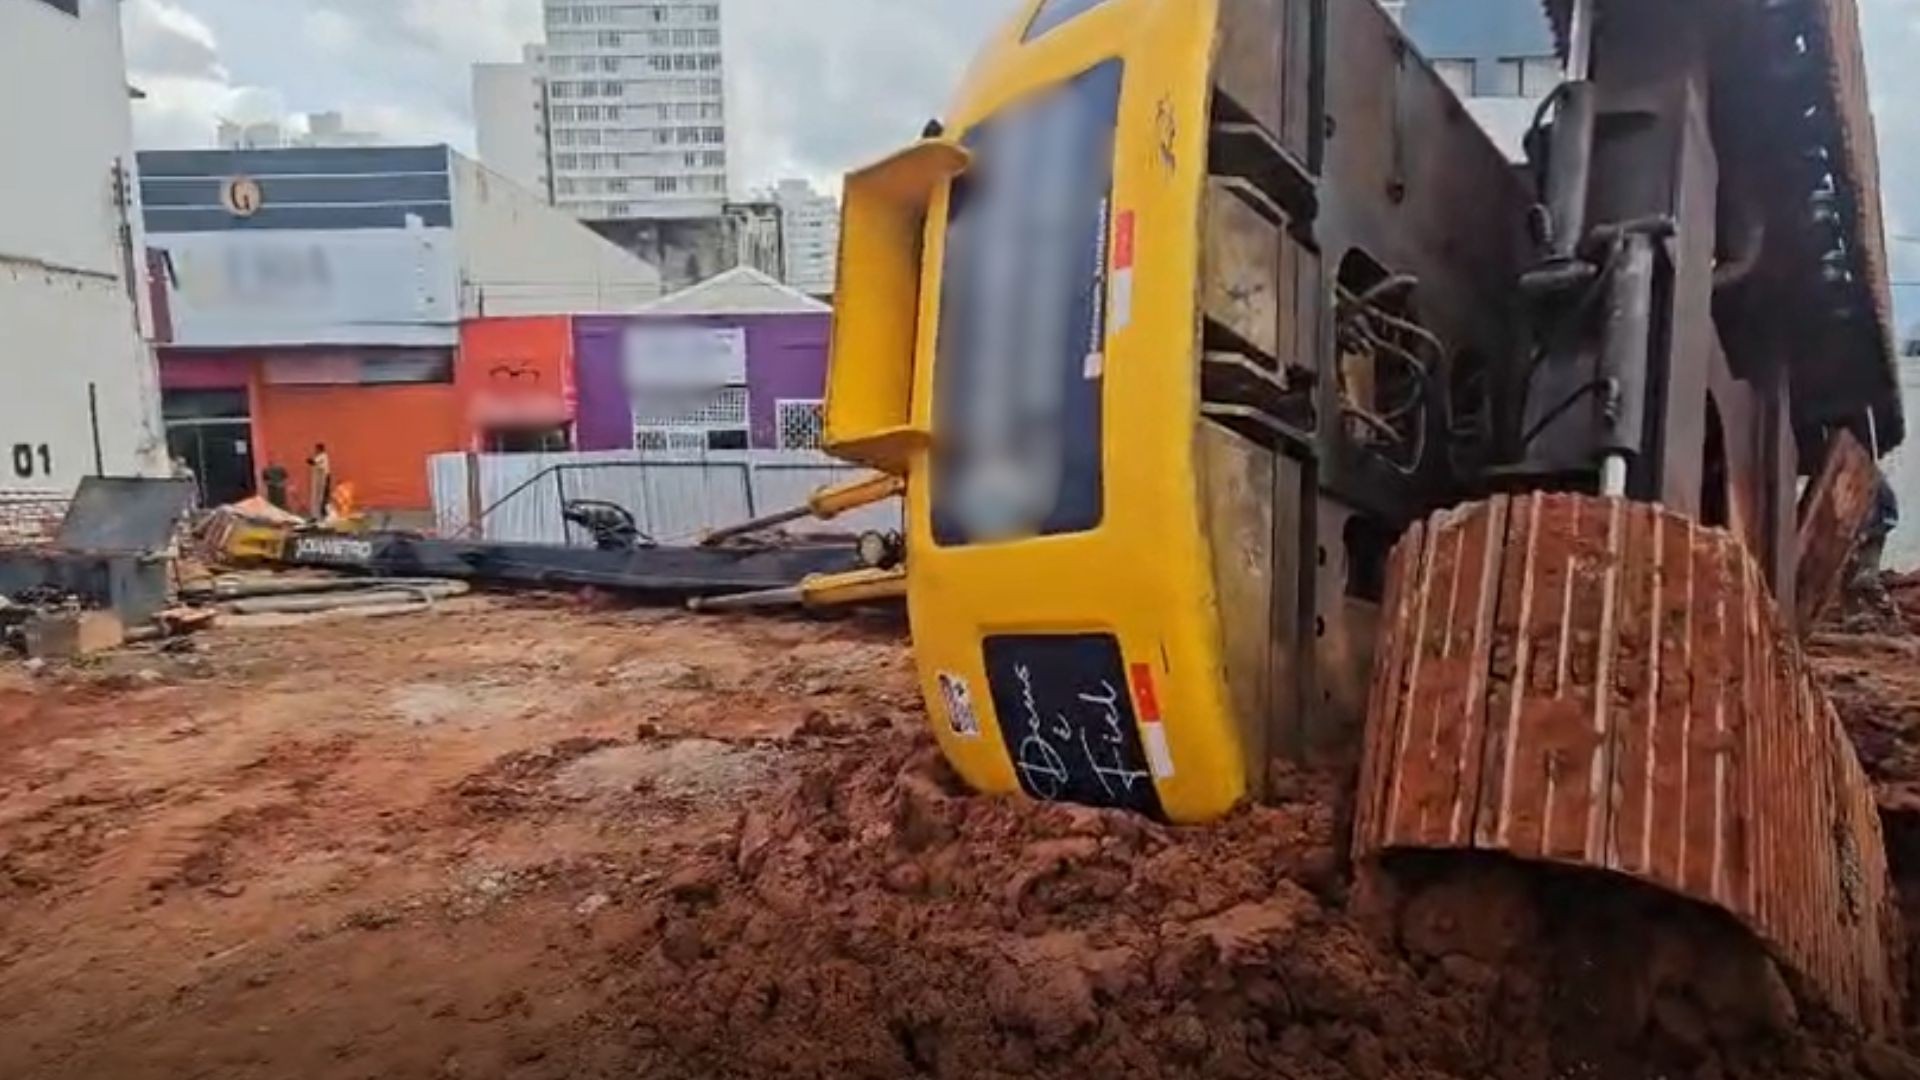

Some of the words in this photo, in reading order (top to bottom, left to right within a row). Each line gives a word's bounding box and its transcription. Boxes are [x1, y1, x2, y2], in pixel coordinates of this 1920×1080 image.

[13, 443, 51, 478] 01
[1014, 662, 1069, 799] Deus
[1078, 679, 1149, 798] Fiel
